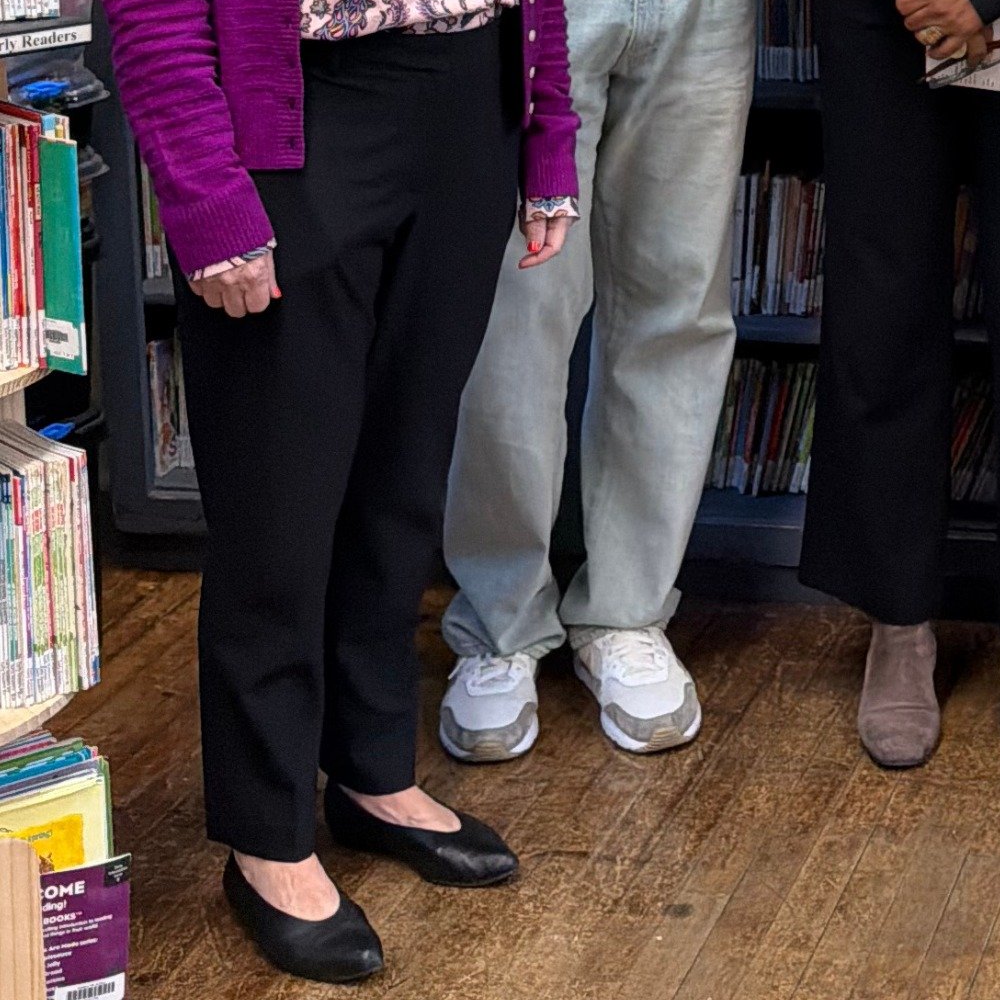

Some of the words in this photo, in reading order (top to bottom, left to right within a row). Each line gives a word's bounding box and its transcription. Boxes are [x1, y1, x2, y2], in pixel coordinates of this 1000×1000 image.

[0, 38, 17, 52] rly
[22, 31, 78, 48] Readers
[41, 880, 86, 900] OME
[42, 900, 68, 912] ding!
